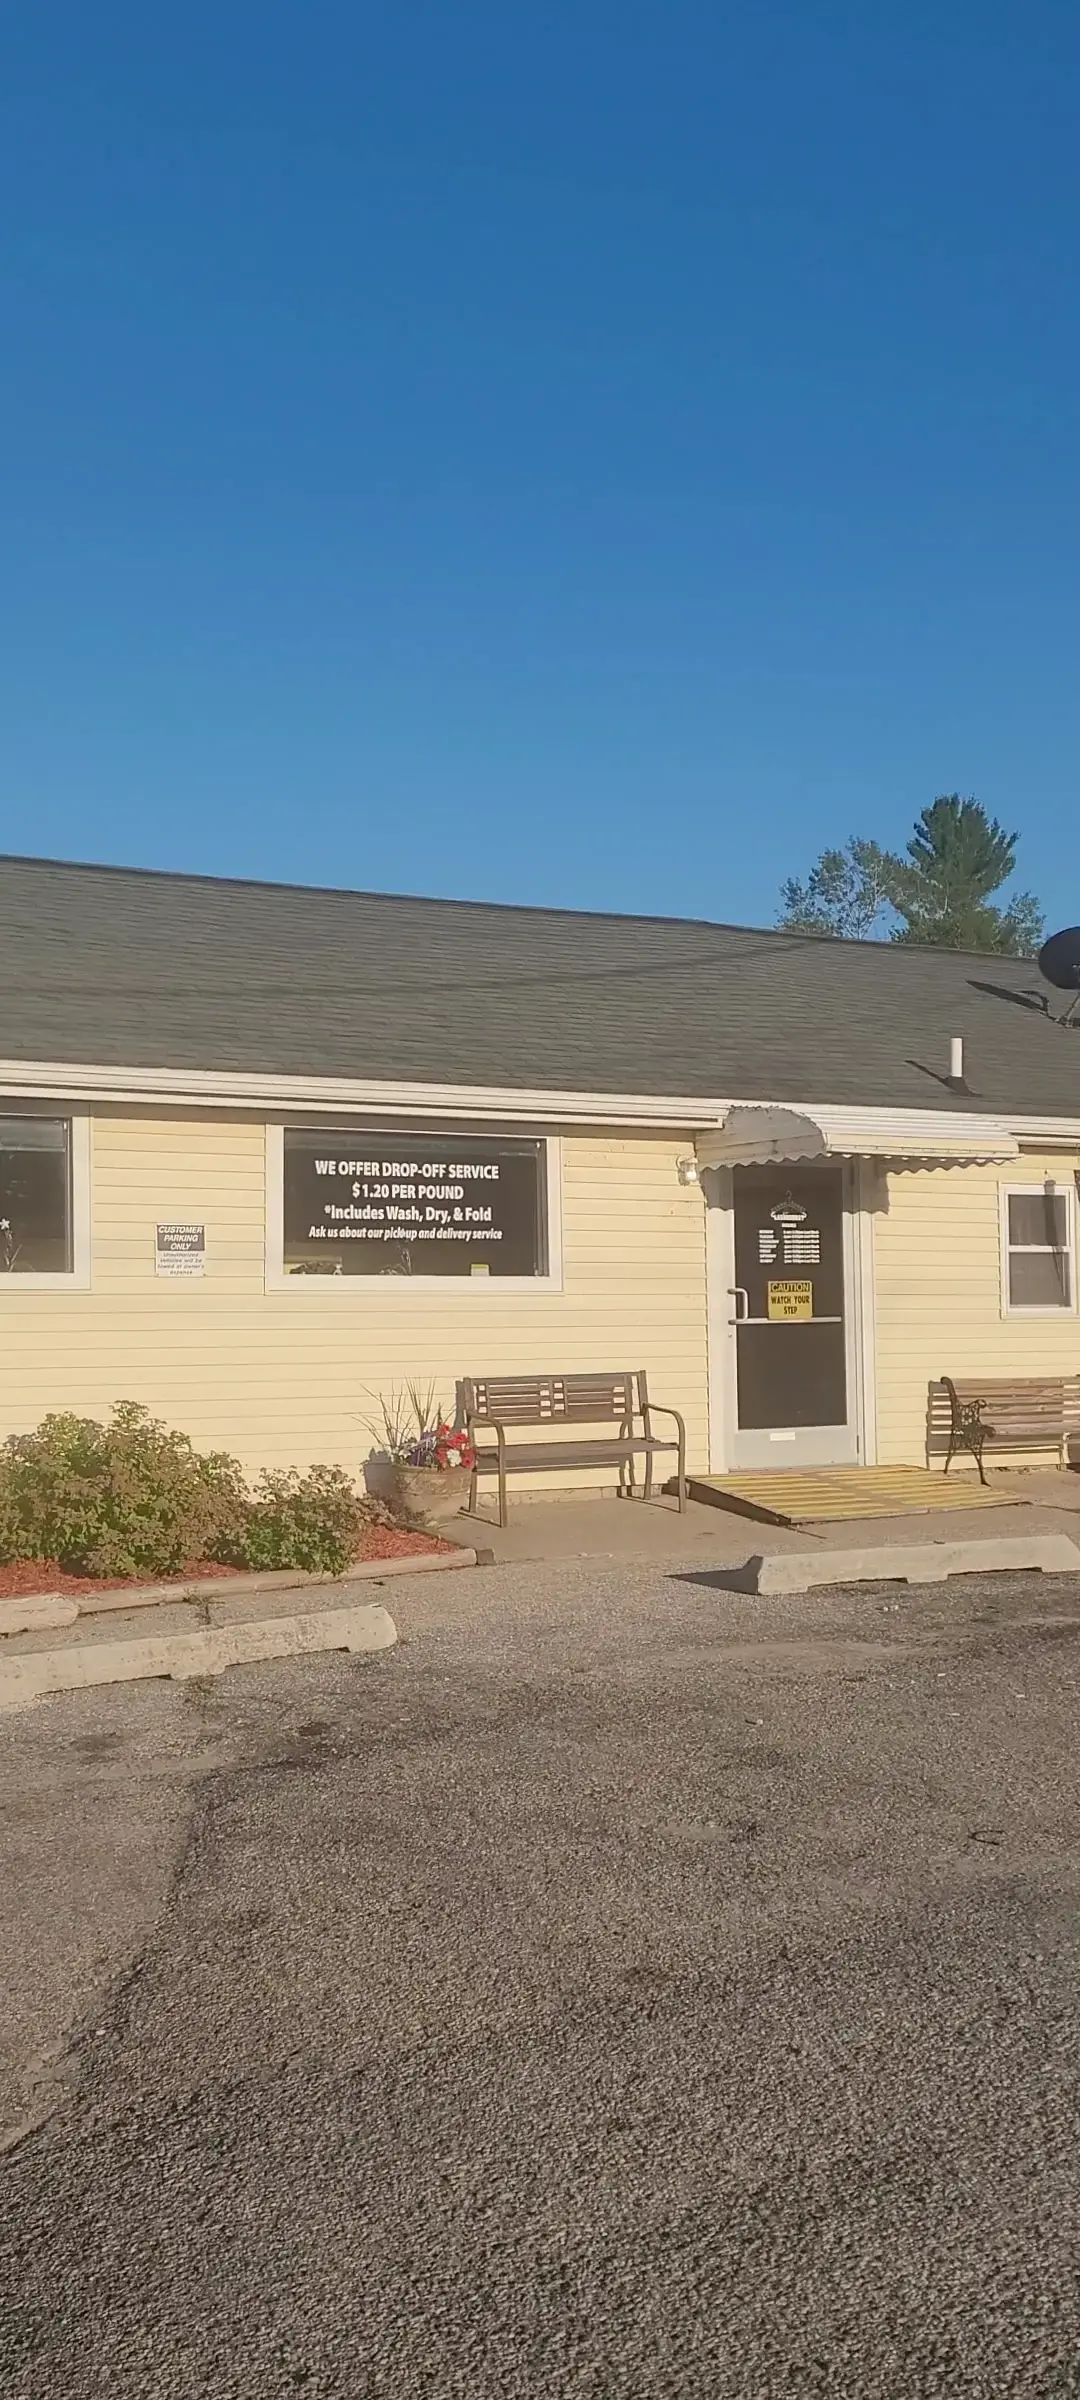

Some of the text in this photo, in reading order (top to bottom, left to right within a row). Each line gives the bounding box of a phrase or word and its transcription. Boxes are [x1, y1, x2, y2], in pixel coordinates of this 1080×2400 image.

[315, 1160, 499, 1179] WE OFFER DROP-OFF SERVICE
[352, 1181, 464, 1200] $1.20 PER POUND
[386, 1206, 423, 1222] Wash,
[425, 1206, 451, 1224] Dry,
[453, 1207, 463, 1221] &
[465, 1207, 492, 1221] Fold
[158, 1226, 203, 1234] CUSTOMER
[308, 1225, 326, 1238] Ask
[327, 1228, 338, 1238] us
[339, 1226, 367, 1238] about
[367, 1228, 383, 1238] our
[418, 1228, 436, 1239] and
[436, 1228, 472, 1242] delivery
[472, 1228, 503, 1240] service
[163, 1234, 199, 1242] PARKING
[170, 1242, 191, 1250] ONLY
[771, 1283, 809, 1292] CAUTION
[771, 1295, 810, 1305] WATCH YOUR
[783, 1305, 798, 1315] STEP
